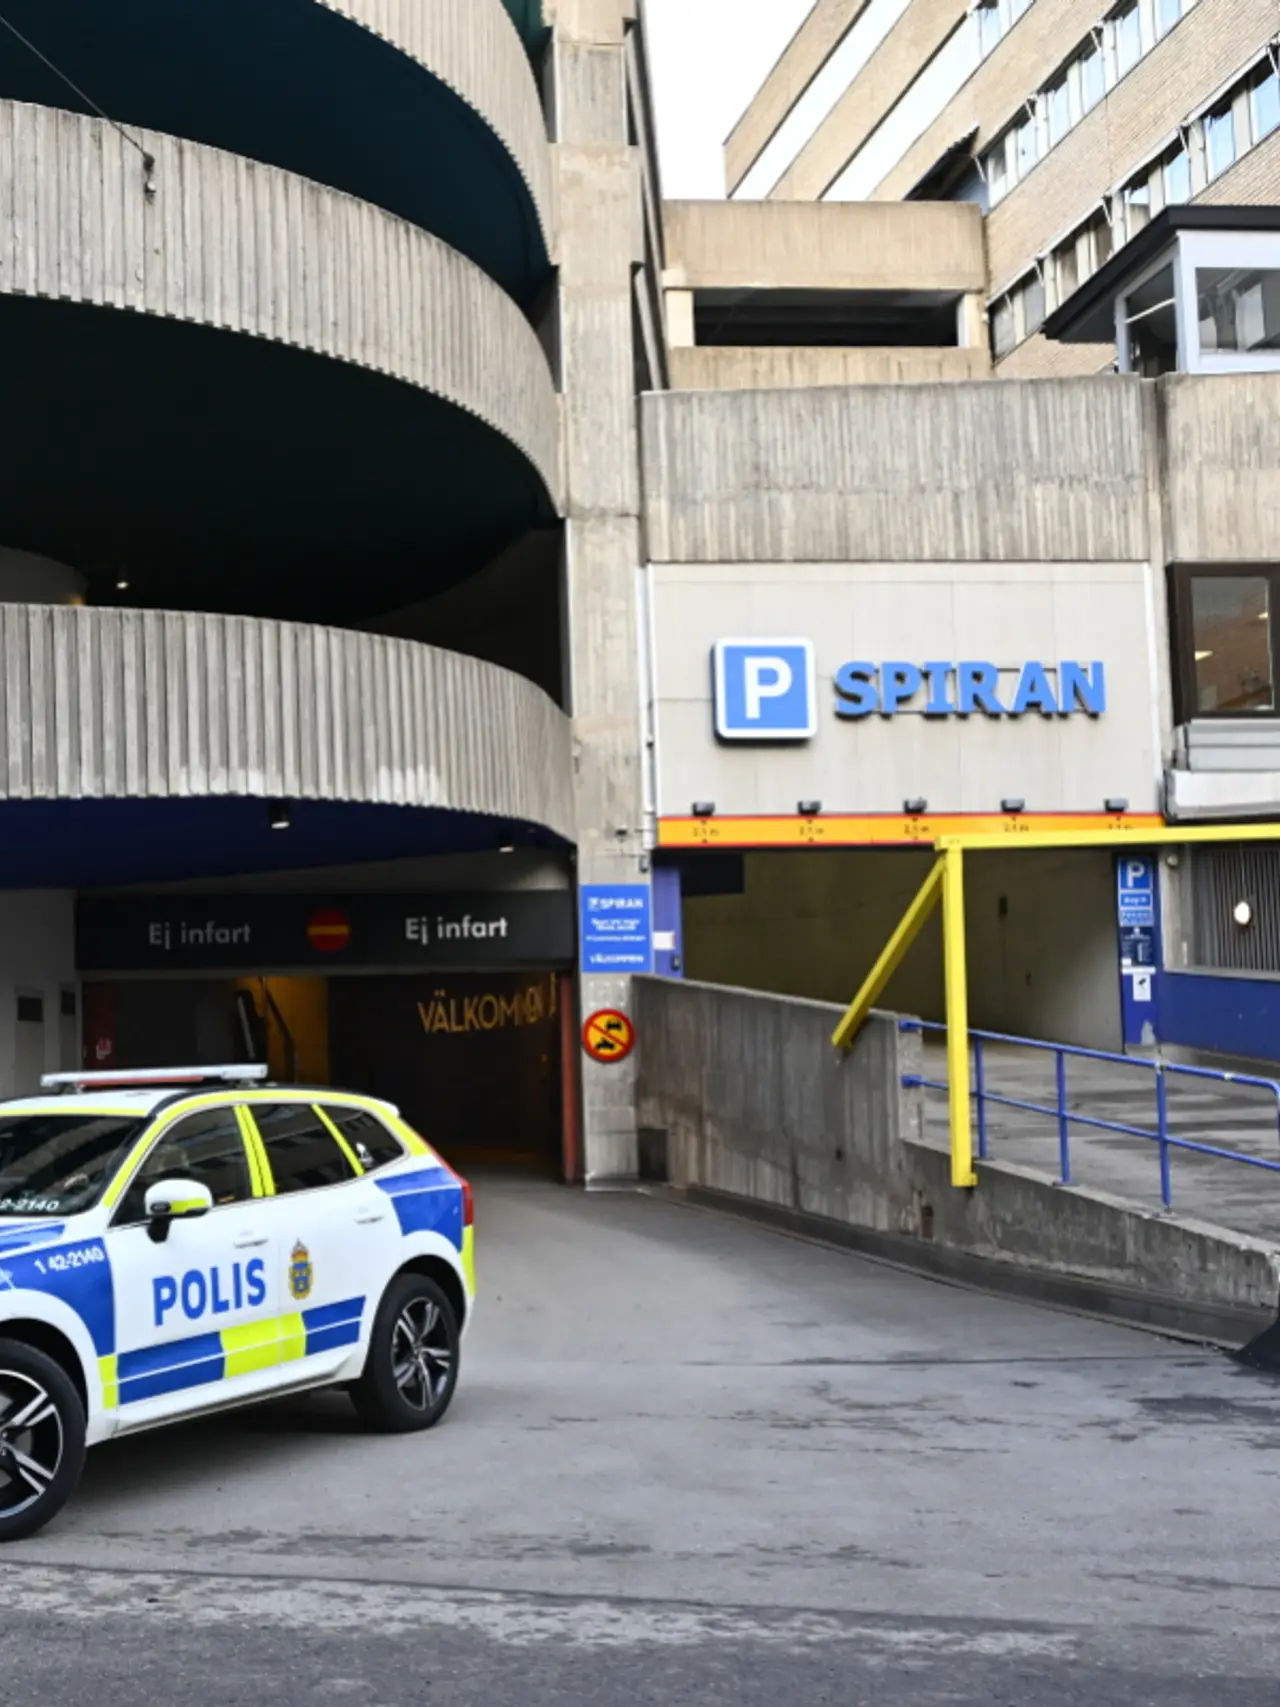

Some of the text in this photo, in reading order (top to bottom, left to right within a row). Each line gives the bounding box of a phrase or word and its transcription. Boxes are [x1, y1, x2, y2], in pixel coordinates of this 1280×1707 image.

[744, 656, 1107, 719] P SPIRAN
[1127, 862, 1145, 888] P
[149, 920, 251, 951] Ej infart
[404, 914, 508, 946] Ej infart
[33, 1245, 106, 1275] 1 42-2140
[152, 1258, 266, 1327] POLIS
